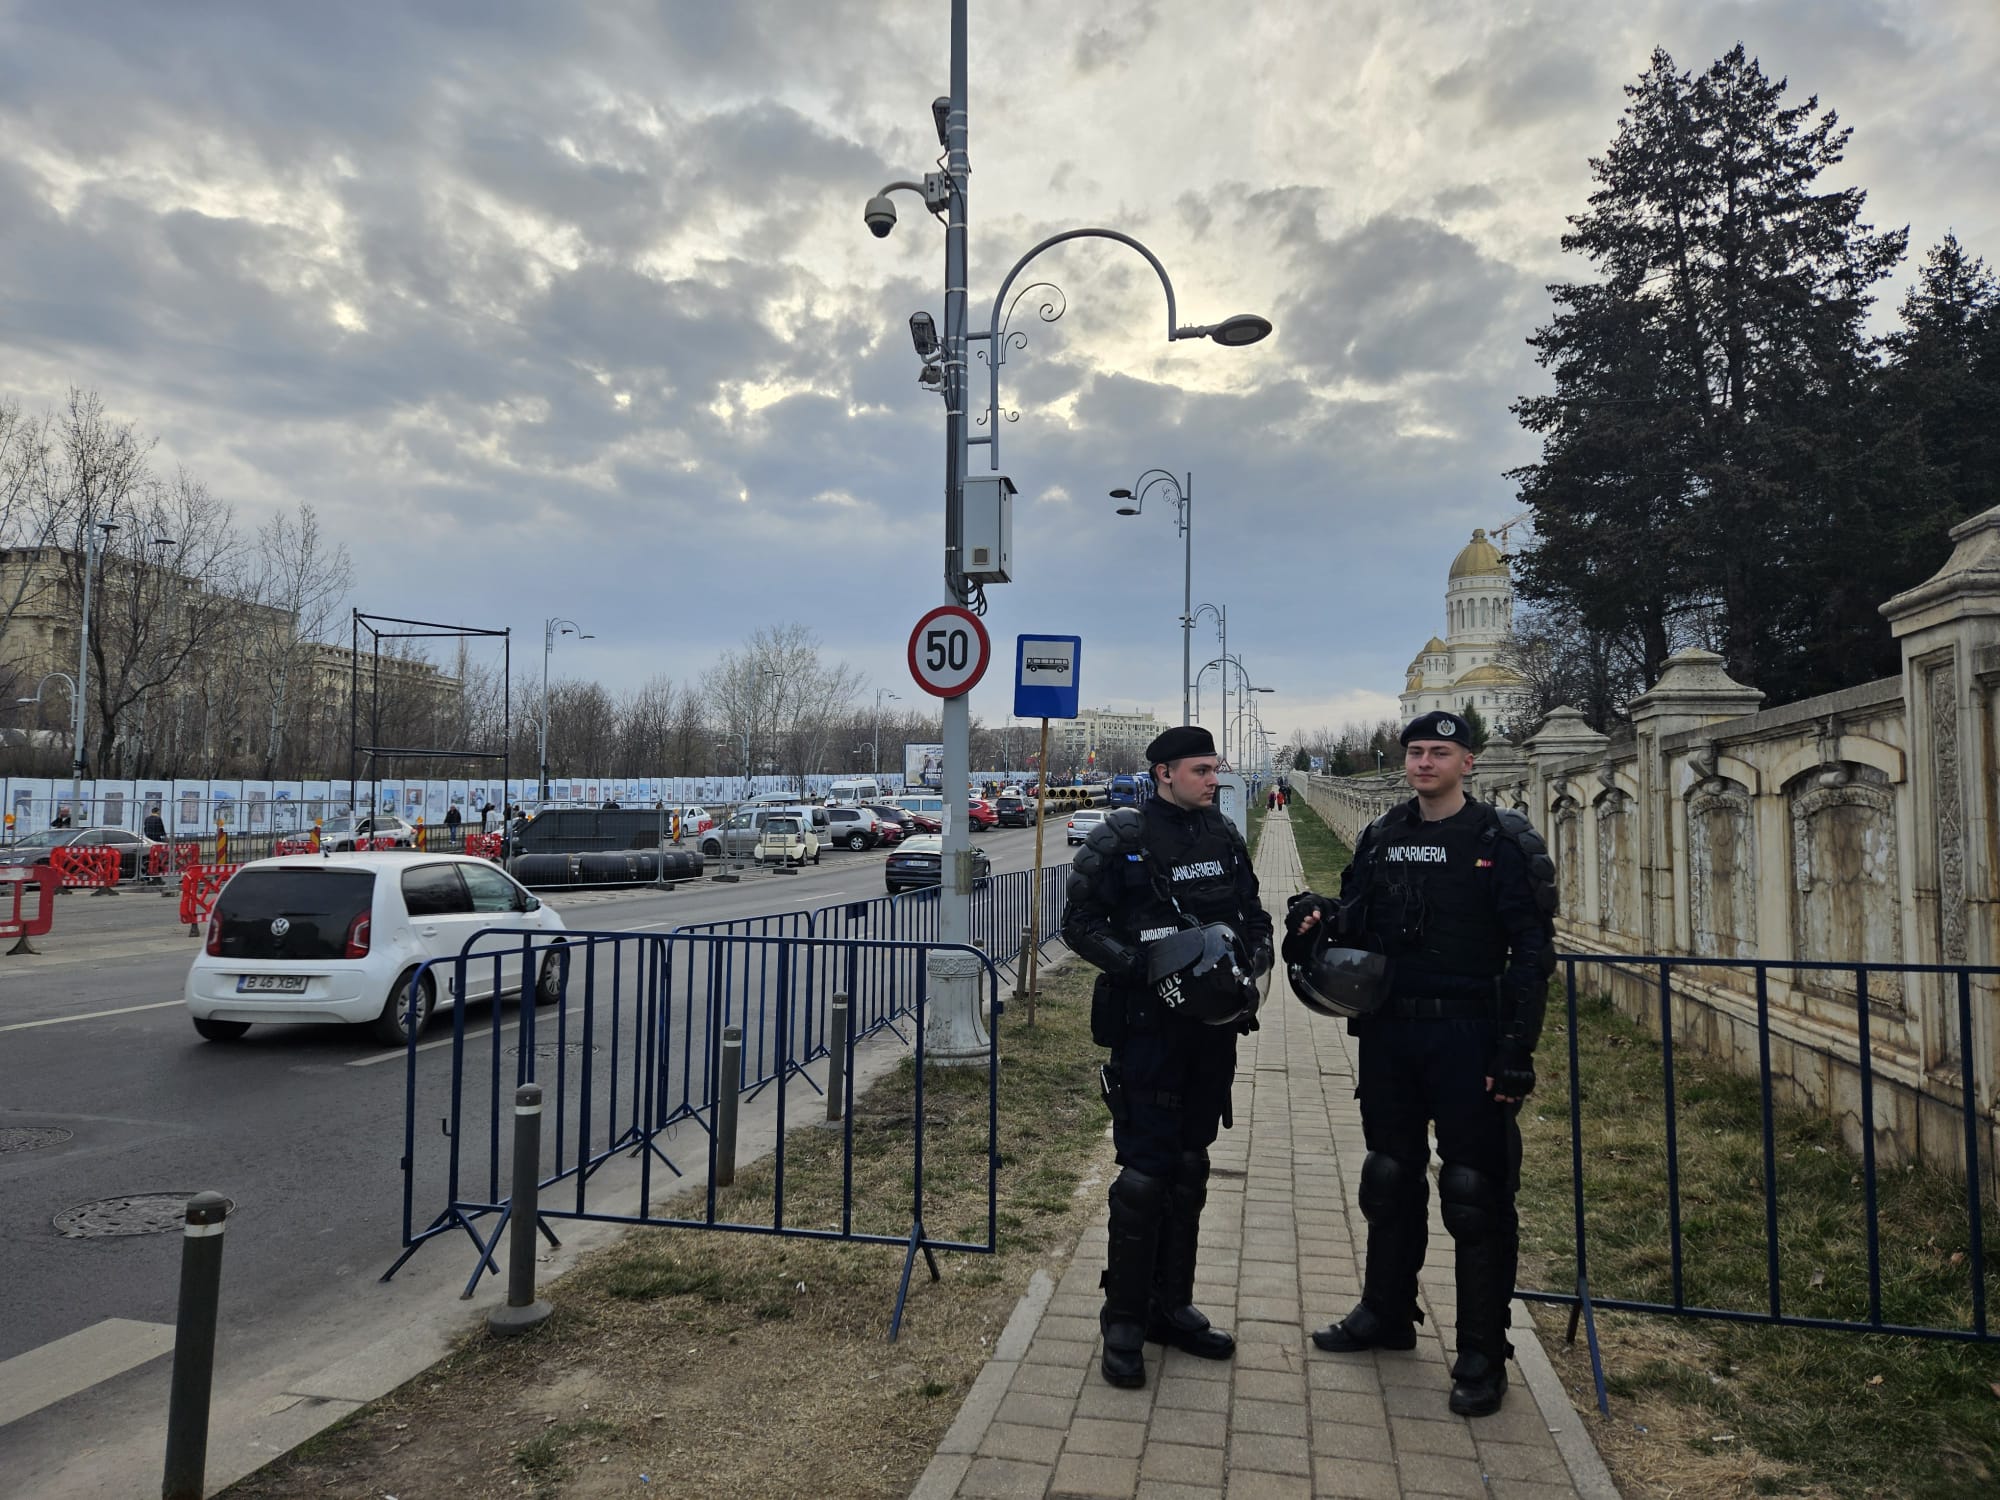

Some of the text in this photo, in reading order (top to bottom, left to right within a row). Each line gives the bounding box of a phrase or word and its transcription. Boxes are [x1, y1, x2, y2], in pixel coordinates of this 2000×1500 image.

[926, 629, 968, 672] 50
[1385, 846, 1447, 863] JANDARMERIA
[1172, 860, 1224, 881] JANDARMERIA
[246, 976, 258, 988] B
